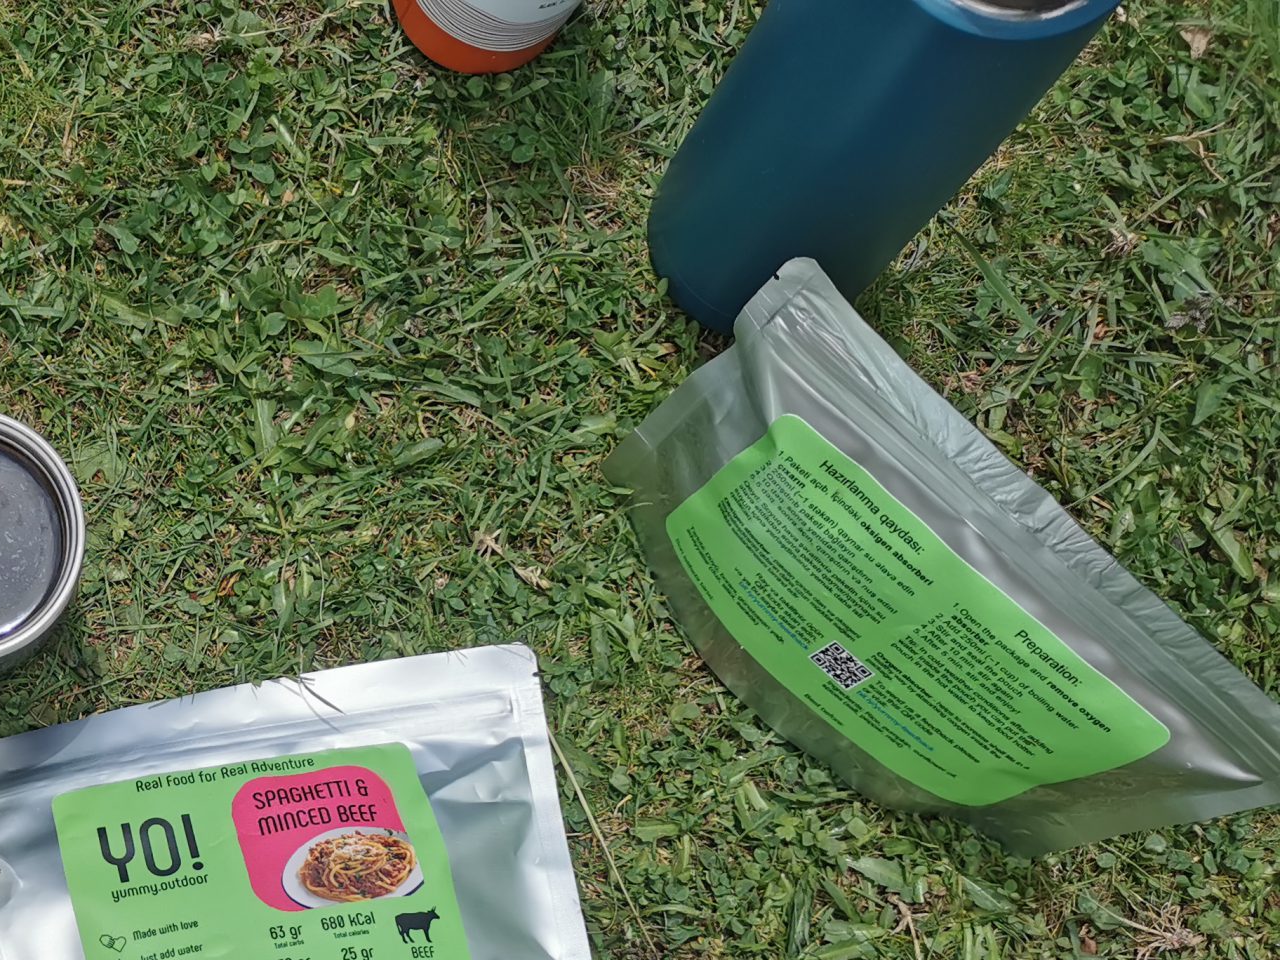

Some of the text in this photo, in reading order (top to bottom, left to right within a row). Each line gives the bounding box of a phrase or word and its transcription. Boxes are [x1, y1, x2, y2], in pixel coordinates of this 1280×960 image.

[784, 456, 812, 480] Paketi
[860, 521, 893, 552] oksigen
[892, 551, 934, 586] absorberi
[819, 460, 925, 555] Hazırlanma qaydası:
[951, 615, 990, 646] absorber
[927, 630, 948, 647] After
[949, 646, 961, 657] 10
[977, 670, 992, 682] stir
[990, 682, 1014, 701] again
[935, 624, 951, 638] Stir
[949, 637, 968, 652] and
[966, 651, 986, 666] seal
[983, 664, 999, 677] the
[996, 676, 1024, 698] pouch
[959, 608, 982, 629] Open
[981, 627, 996, 641] the
[994, 640, 1030, 668] package
[1029, 667, 1049, 682] and
[1046, 681, 1079, 708] remove
[1078, 707, 1111, 733] oxygen
[1014, 629, 1082, 687] Preparation:
[942, 620, 962, 635] Add
[959, 633, 987, 655] 250ml
[1018, 682, 1030, 690] of
[1027, 689, 1055, 713] boiling
[1055, 711, 1079, 730] water
[135, 758, 315, 793] Real Food for Real Adventure
[252, 778, 369, 810] SPAGHETTI &
[258, 804, 377, 836] MINCED BEEF
[97, 814, 203, 883] YO!
[111, 874, 208, 903] yummy.outdoor
[132, 920, 199, 941] Made with love
[269, 911, 376, 940] 63 gr 680 kCal
[273, 941, 289, 950] Total
[333, 931, 348, 939] Total
[159, 947, 176, 960] add
[177, 944, 203, 956] water
[410, 945, 435, 959] BEEF
